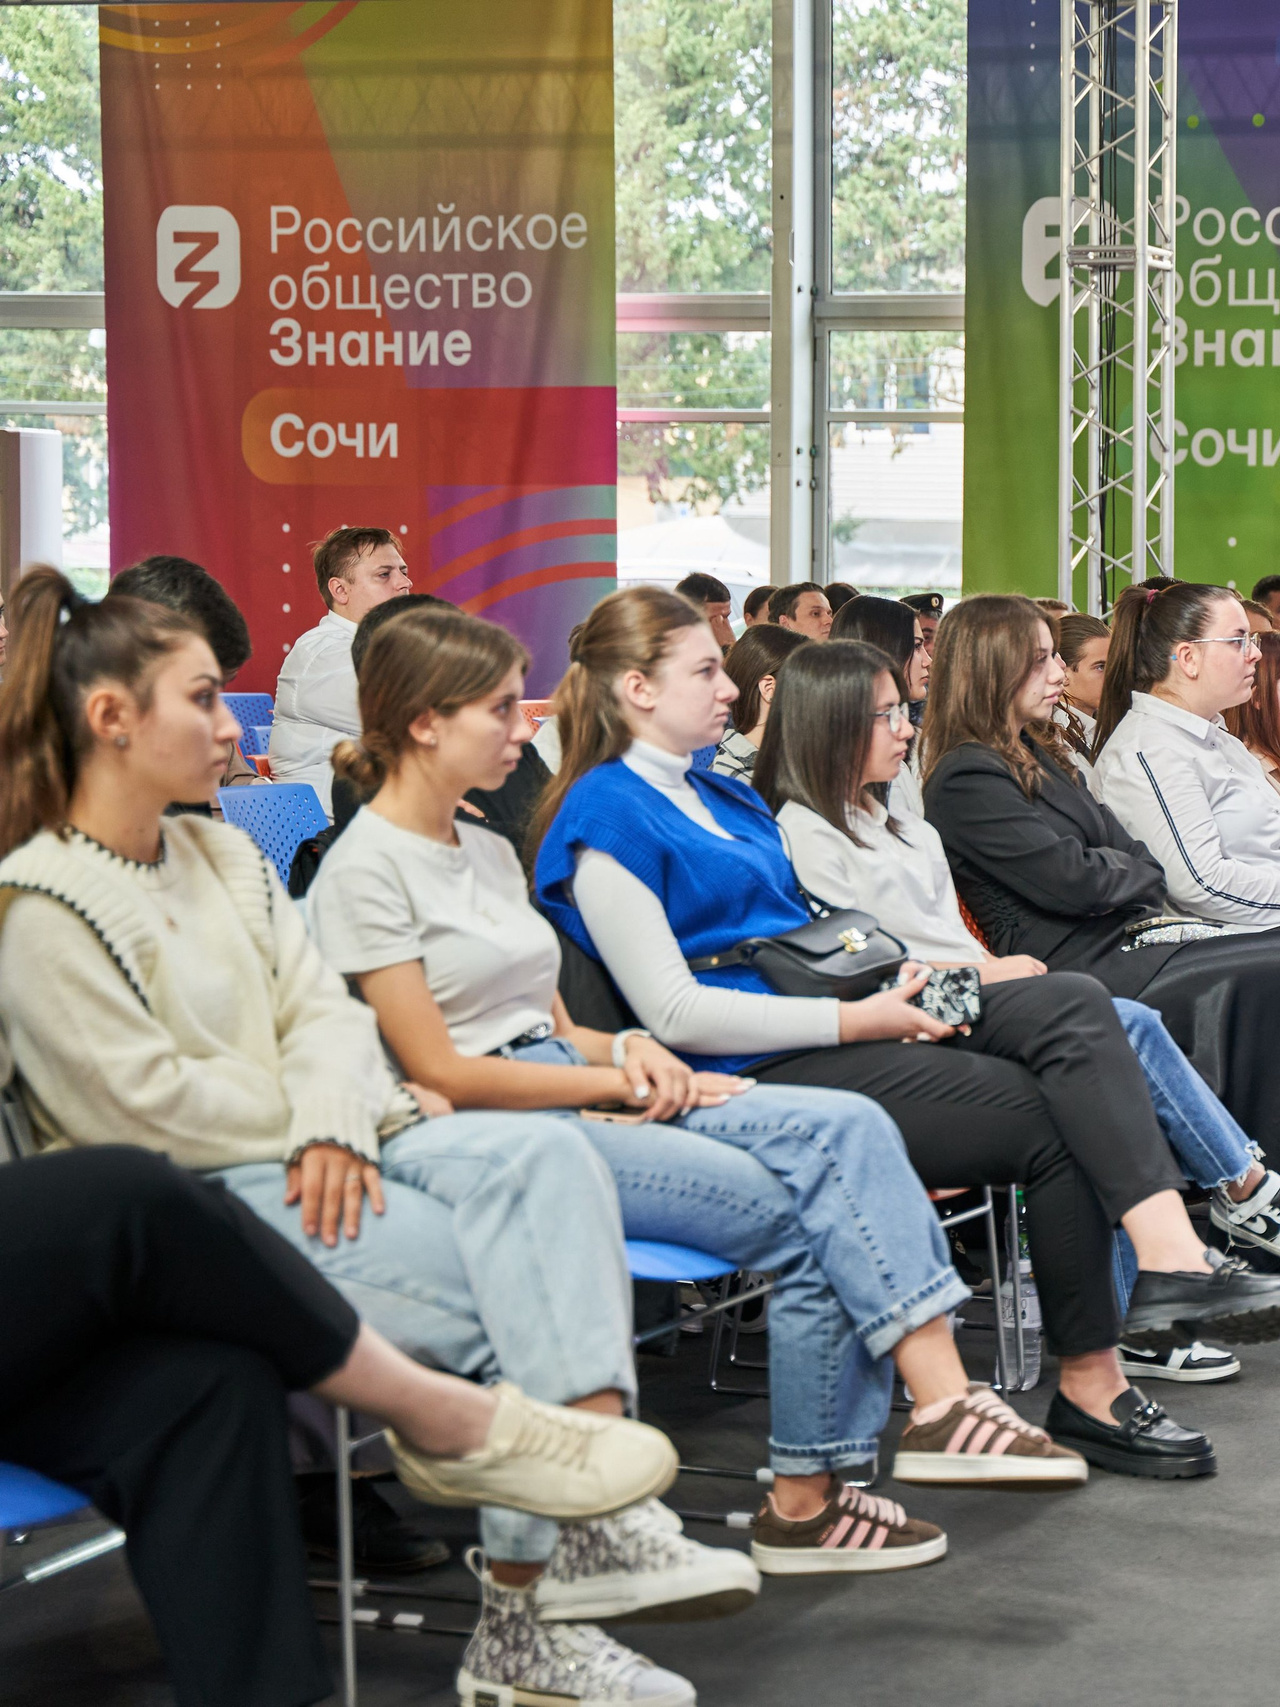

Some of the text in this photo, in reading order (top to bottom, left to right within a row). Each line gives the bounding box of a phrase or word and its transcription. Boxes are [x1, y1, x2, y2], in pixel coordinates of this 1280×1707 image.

[271, 203, 588, 254] Российское
[269, 261, 534, 318] общество
[269, 317, 473, 368] Знание
[269, 411, 399, 460] Сочи
